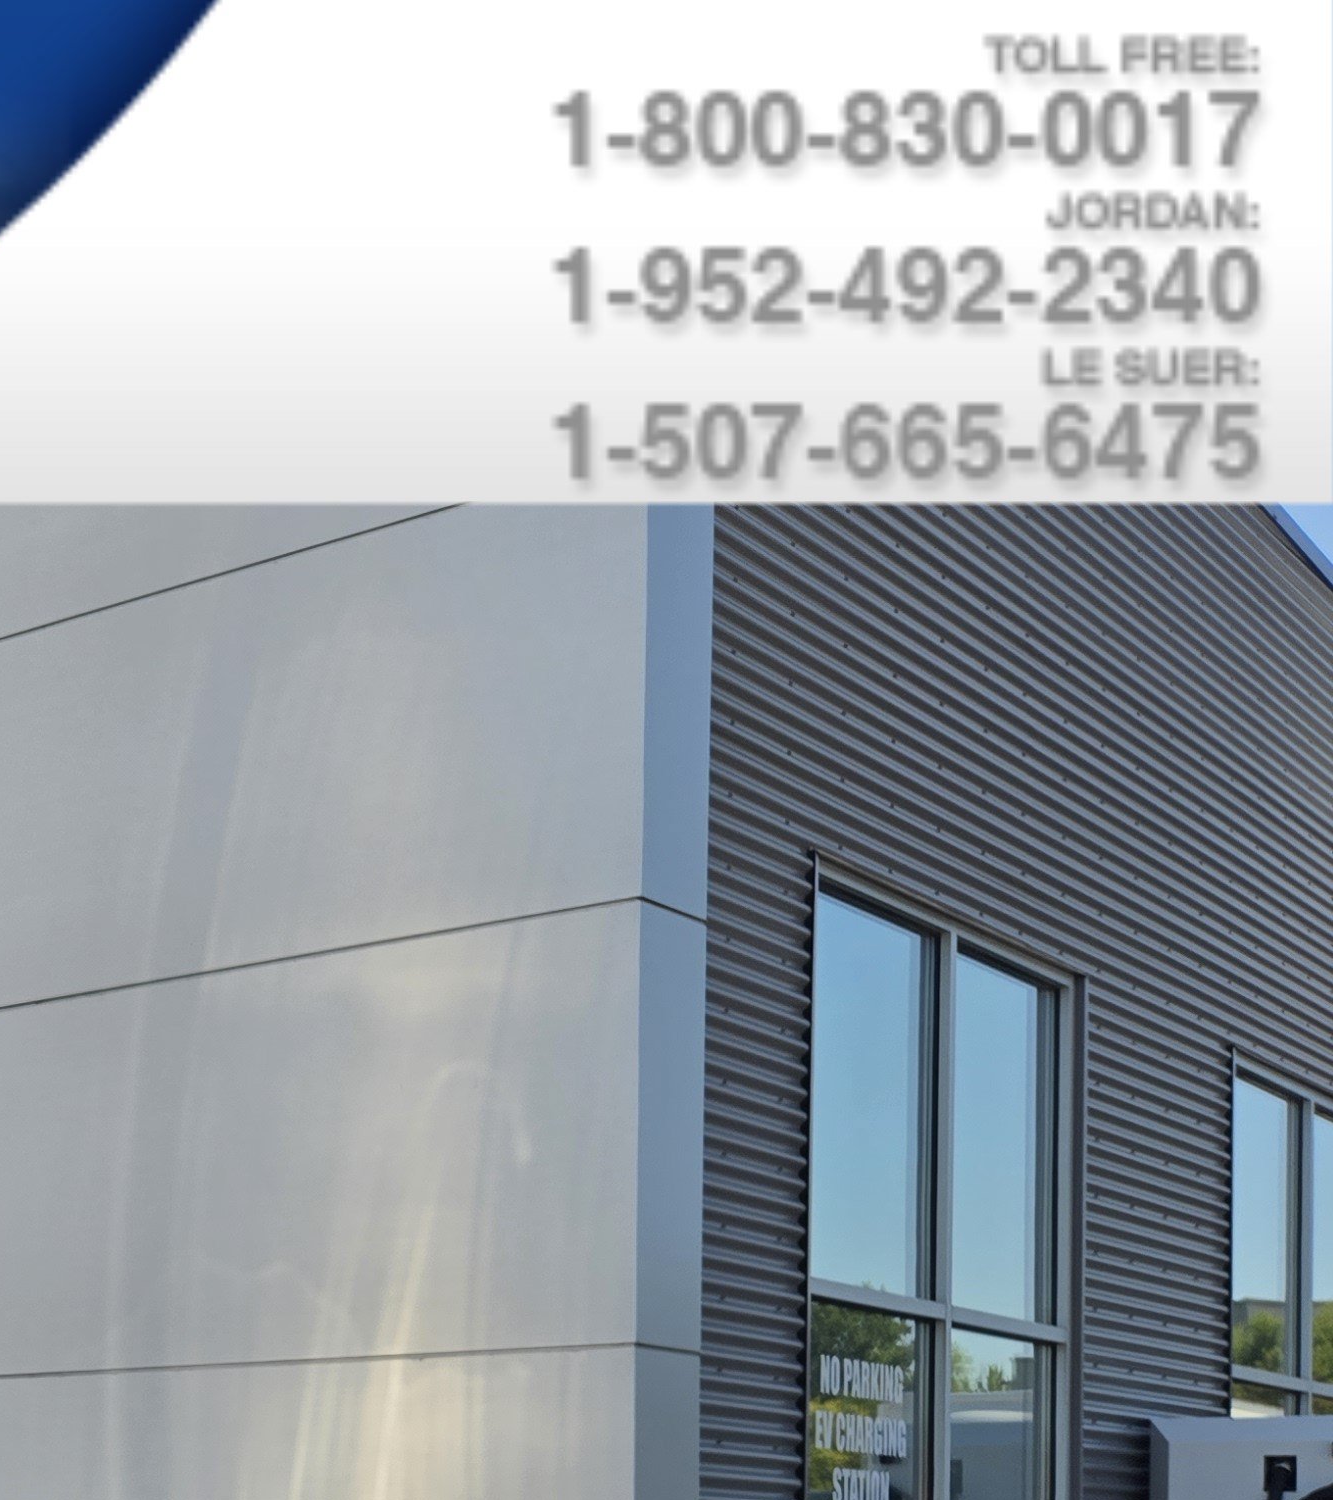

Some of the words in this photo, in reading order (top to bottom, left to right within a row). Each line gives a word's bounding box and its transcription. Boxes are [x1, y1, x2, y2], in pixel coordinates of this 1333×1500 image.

[819, 1354, 841, 1396] NO
[843, 1357, 905, 1405] PARKING
[815, 1409, 834, 1450] EV
[835, 1411, 908, 1459] CHARGING
